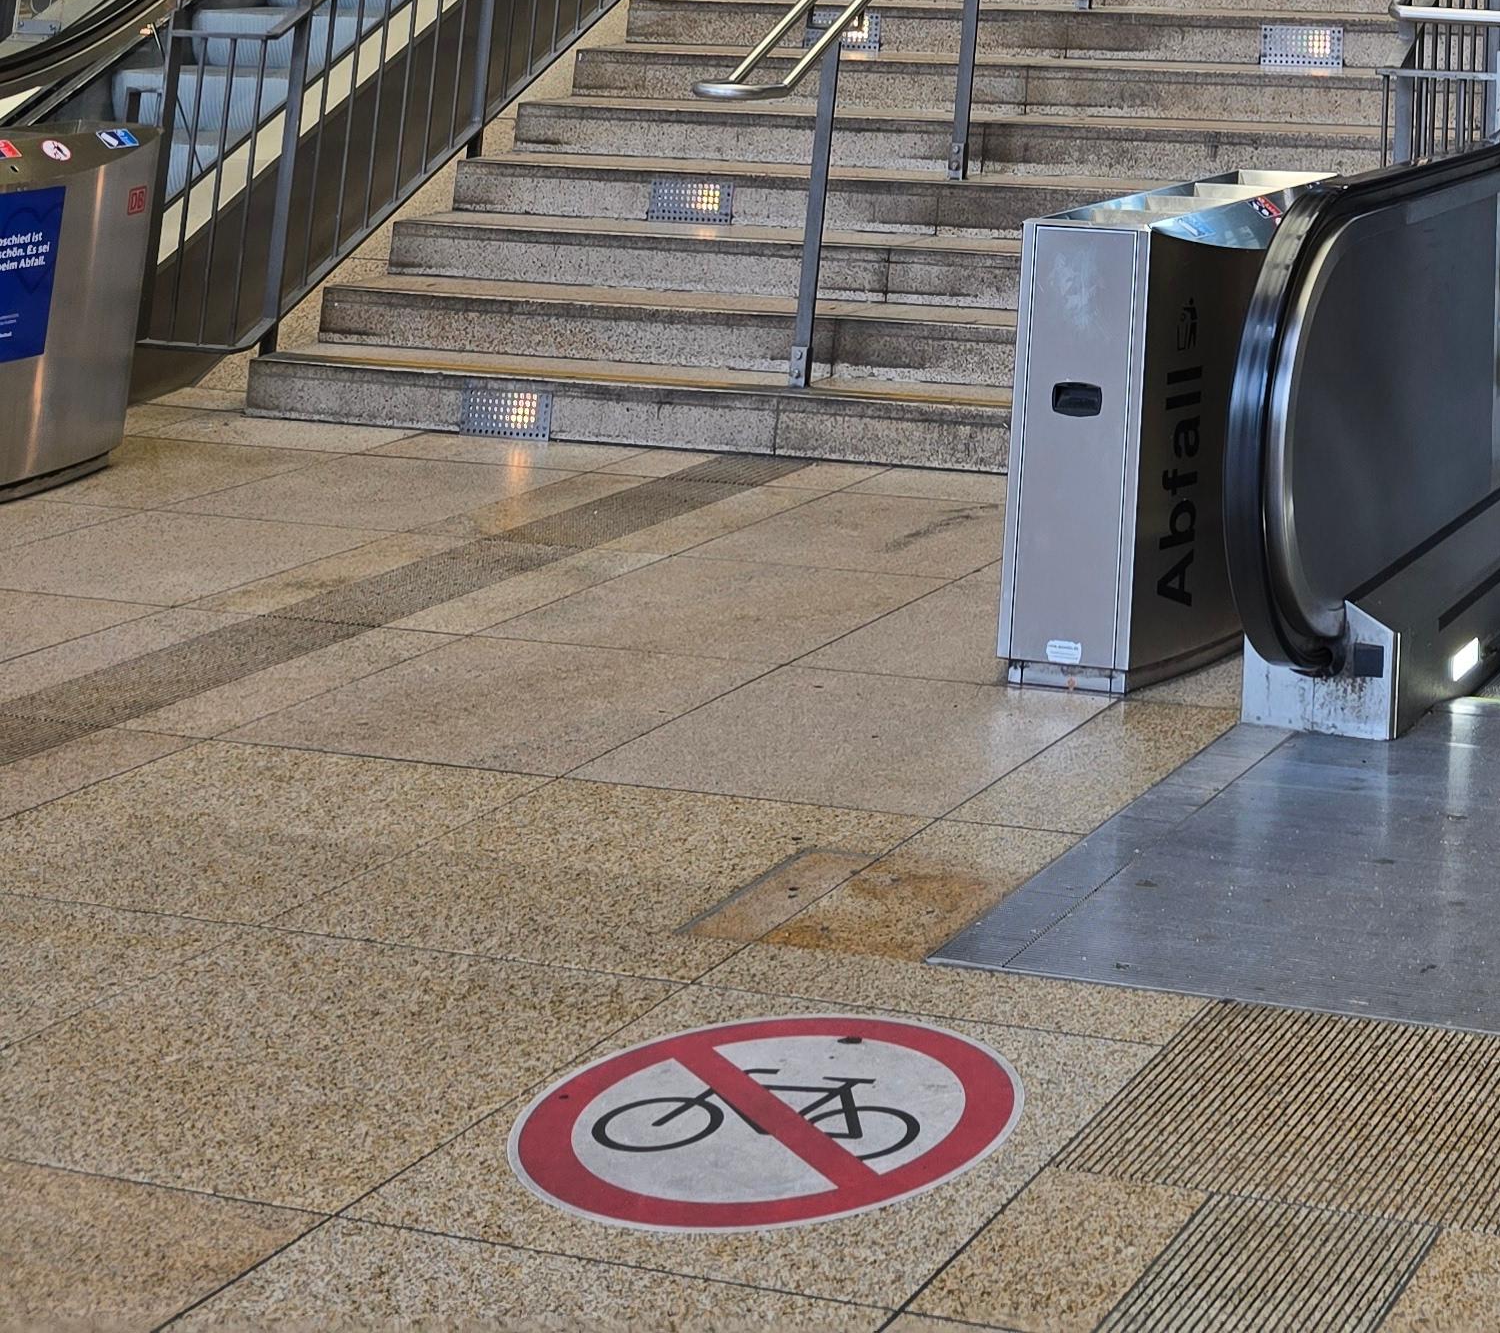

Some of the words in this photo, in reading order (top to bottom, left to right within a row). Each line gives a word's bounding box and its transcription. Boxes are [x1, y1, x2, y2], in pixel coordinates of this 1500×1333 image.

[32, 232, 42, 243] ist
[27, 244, 37, 255] Es
[38, 241, 50, 253] sei
[19, 255, 45, 269] Abfall.
[1156, 365, 1204, 607] Abfall
